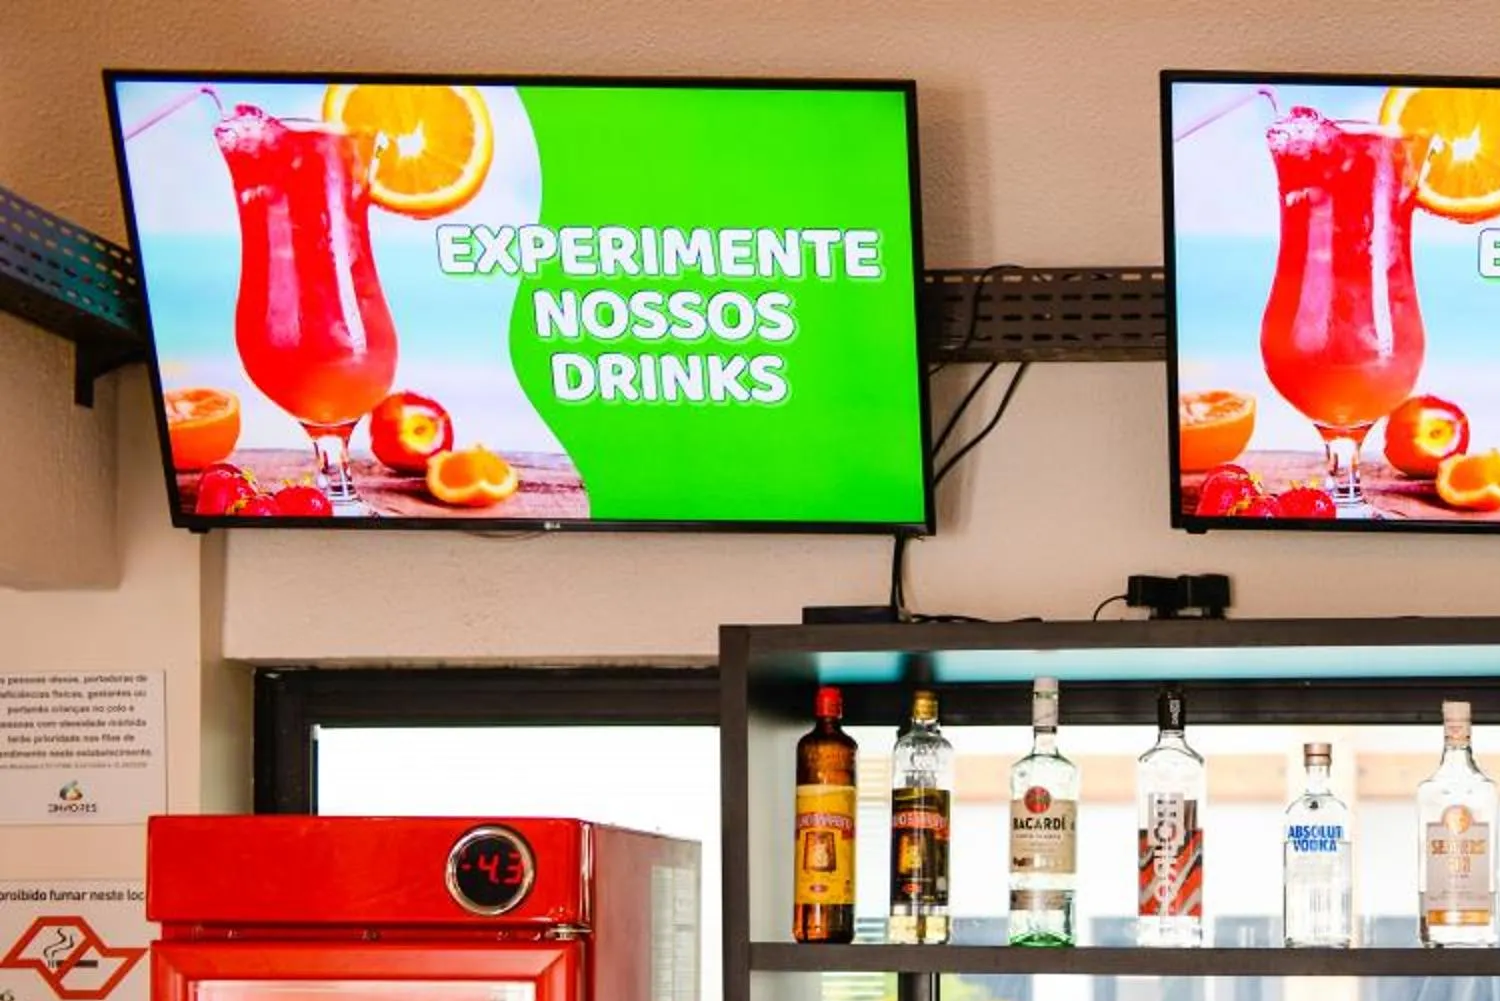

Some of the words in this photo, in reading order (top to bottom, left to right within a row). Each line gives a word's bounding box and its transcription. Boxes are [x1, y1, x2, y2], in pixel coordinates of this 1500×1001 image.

[436, 224, 882, 278] EXPERIMENTE
[532, 290, 796, 342] NOSSOS
[550, 351, 788, 403] DRINKS
[92, 705, 104, 713] no
[107, 704, 127, 713] colo
[1288, 824, 1343, 839] ABSOLUT
[1293, 839, 1338, 852] VODKA
[50, 888, 88, 901] fumar
[90, 889, 124, 901] neste
